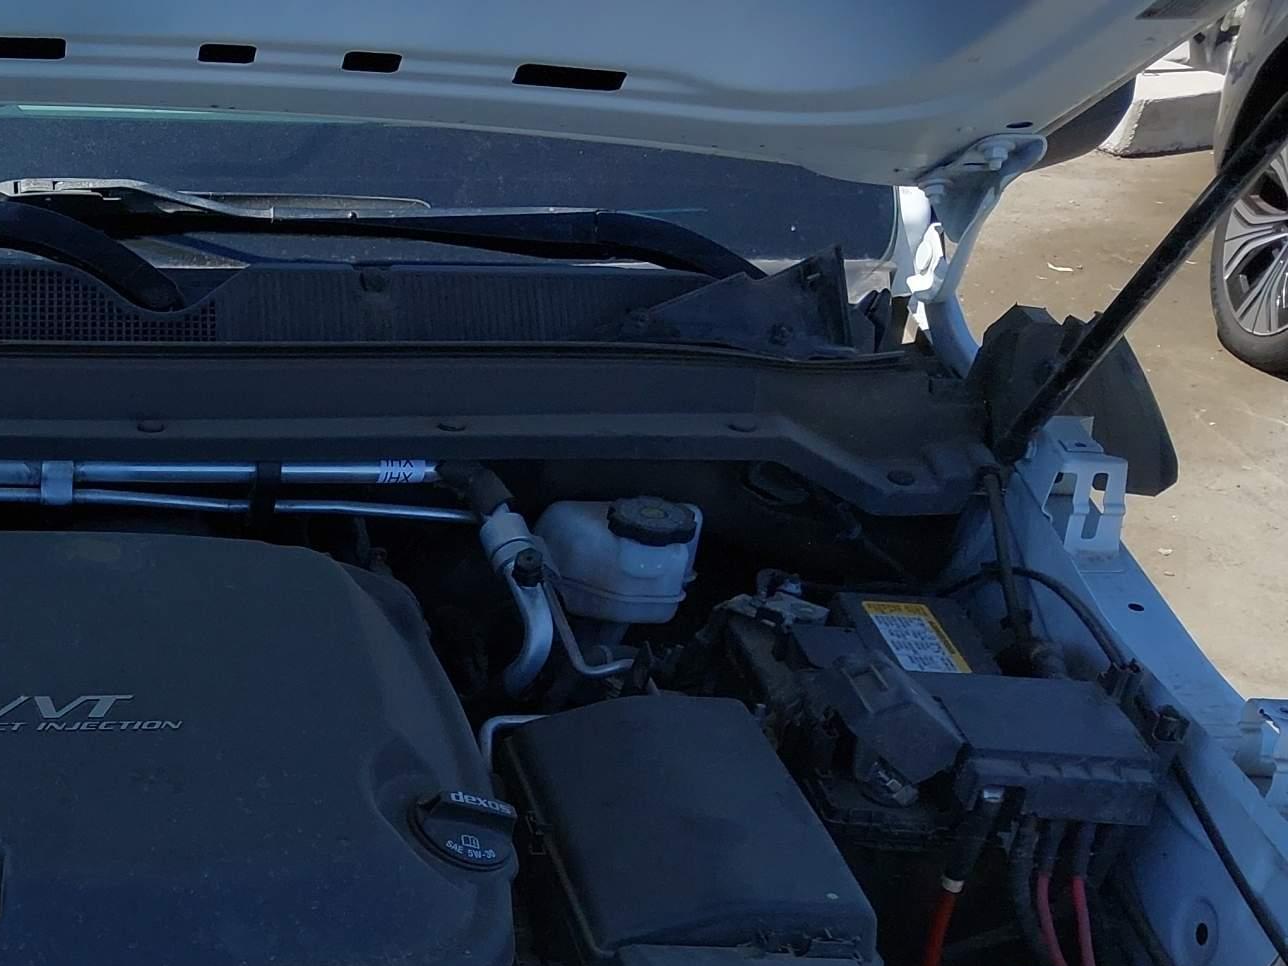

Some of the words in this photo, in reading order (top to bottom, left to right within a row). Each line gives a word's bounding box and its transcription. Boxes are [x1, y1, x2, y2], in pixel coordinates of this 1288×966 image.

[37, 720, 183, 731] INJECTION
[450, 791, 512, 814] dexos
[445, 840, 464, 854] SAE
[467, 848, 496, 858] 5W-30
